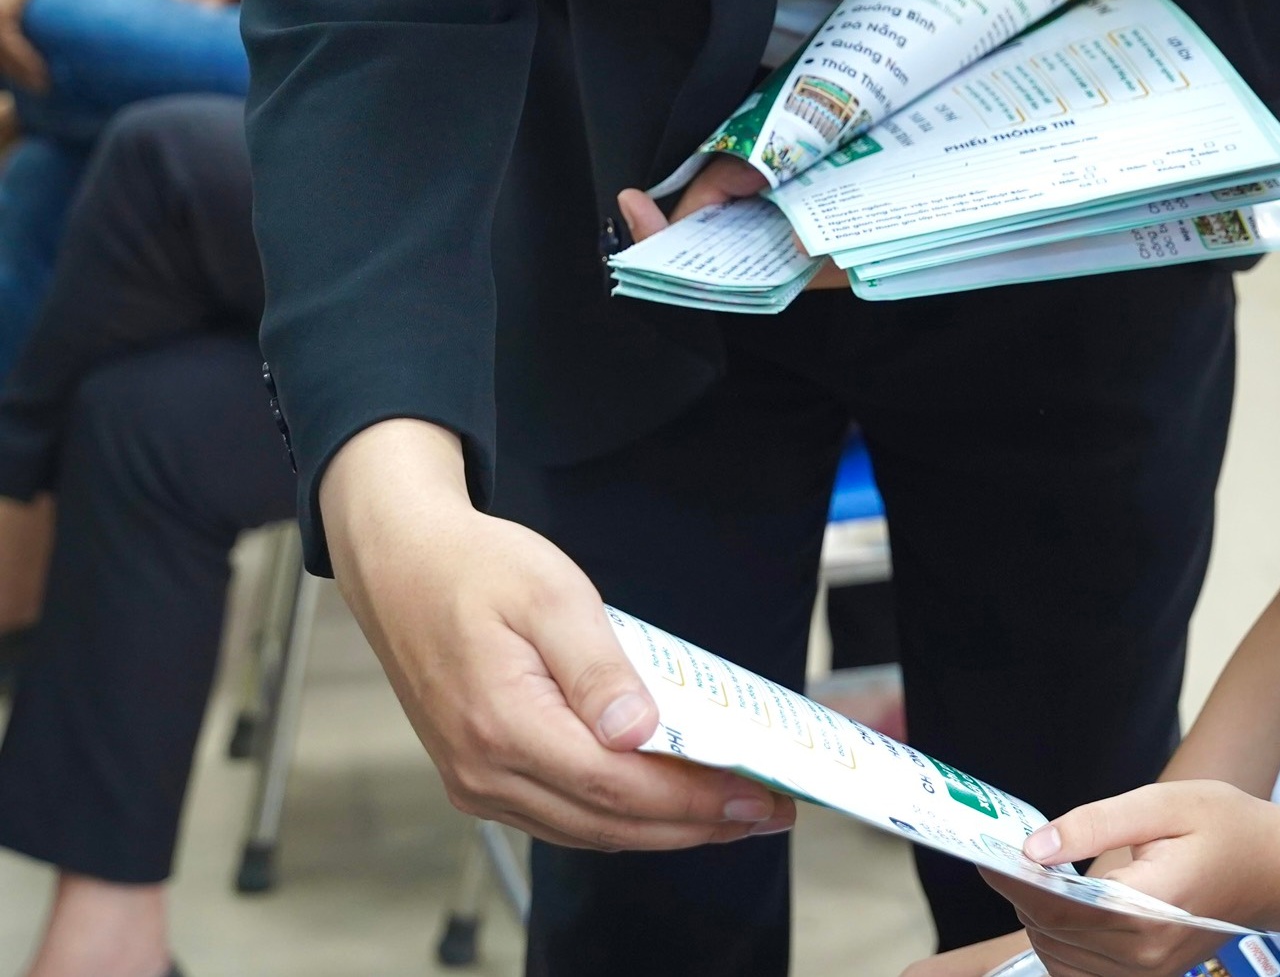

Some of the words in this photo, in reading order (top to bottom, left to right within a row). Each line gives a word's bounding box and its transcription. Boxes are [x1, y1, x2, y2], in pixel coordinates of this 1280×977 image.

[944, 135, 988, 153] PHIẾU
[992, 124, 1047, 142] THÔNG
[1051, 118, 1076, 131] TIN
